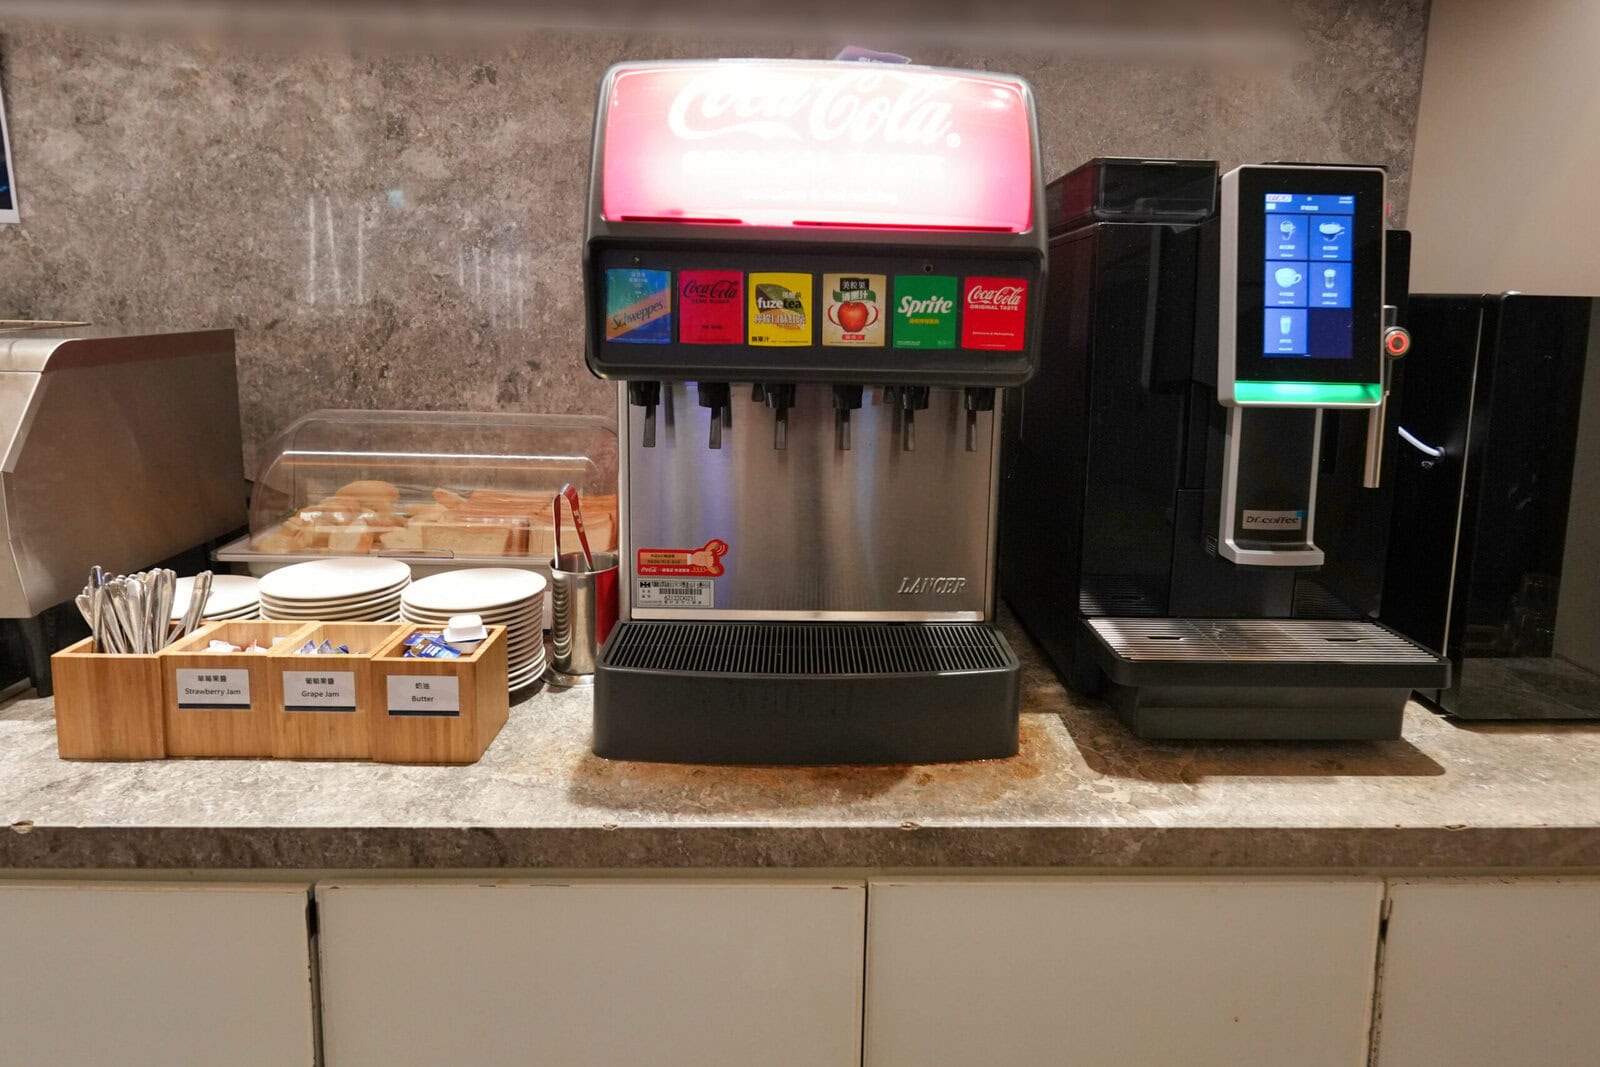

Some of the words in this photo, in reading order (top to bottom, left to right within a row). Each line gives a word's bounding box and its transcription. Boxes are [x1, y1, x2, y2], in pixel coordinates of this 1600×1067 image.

[683, 280, 739, 298] Coca-Cola
[967, 285, 1024, 305] Coca-Cola
[612, 301, 664, 330] Schweppes
[898, 295, 953, 318] Sprite
[897, 576, 967, 594] LANCER
[184, 687, 225, 697] Strawberry
[226, 688, 241, 696] Jam
[301, 690, 324, 699] Grape
[411, 695, 434, 703] Butter
